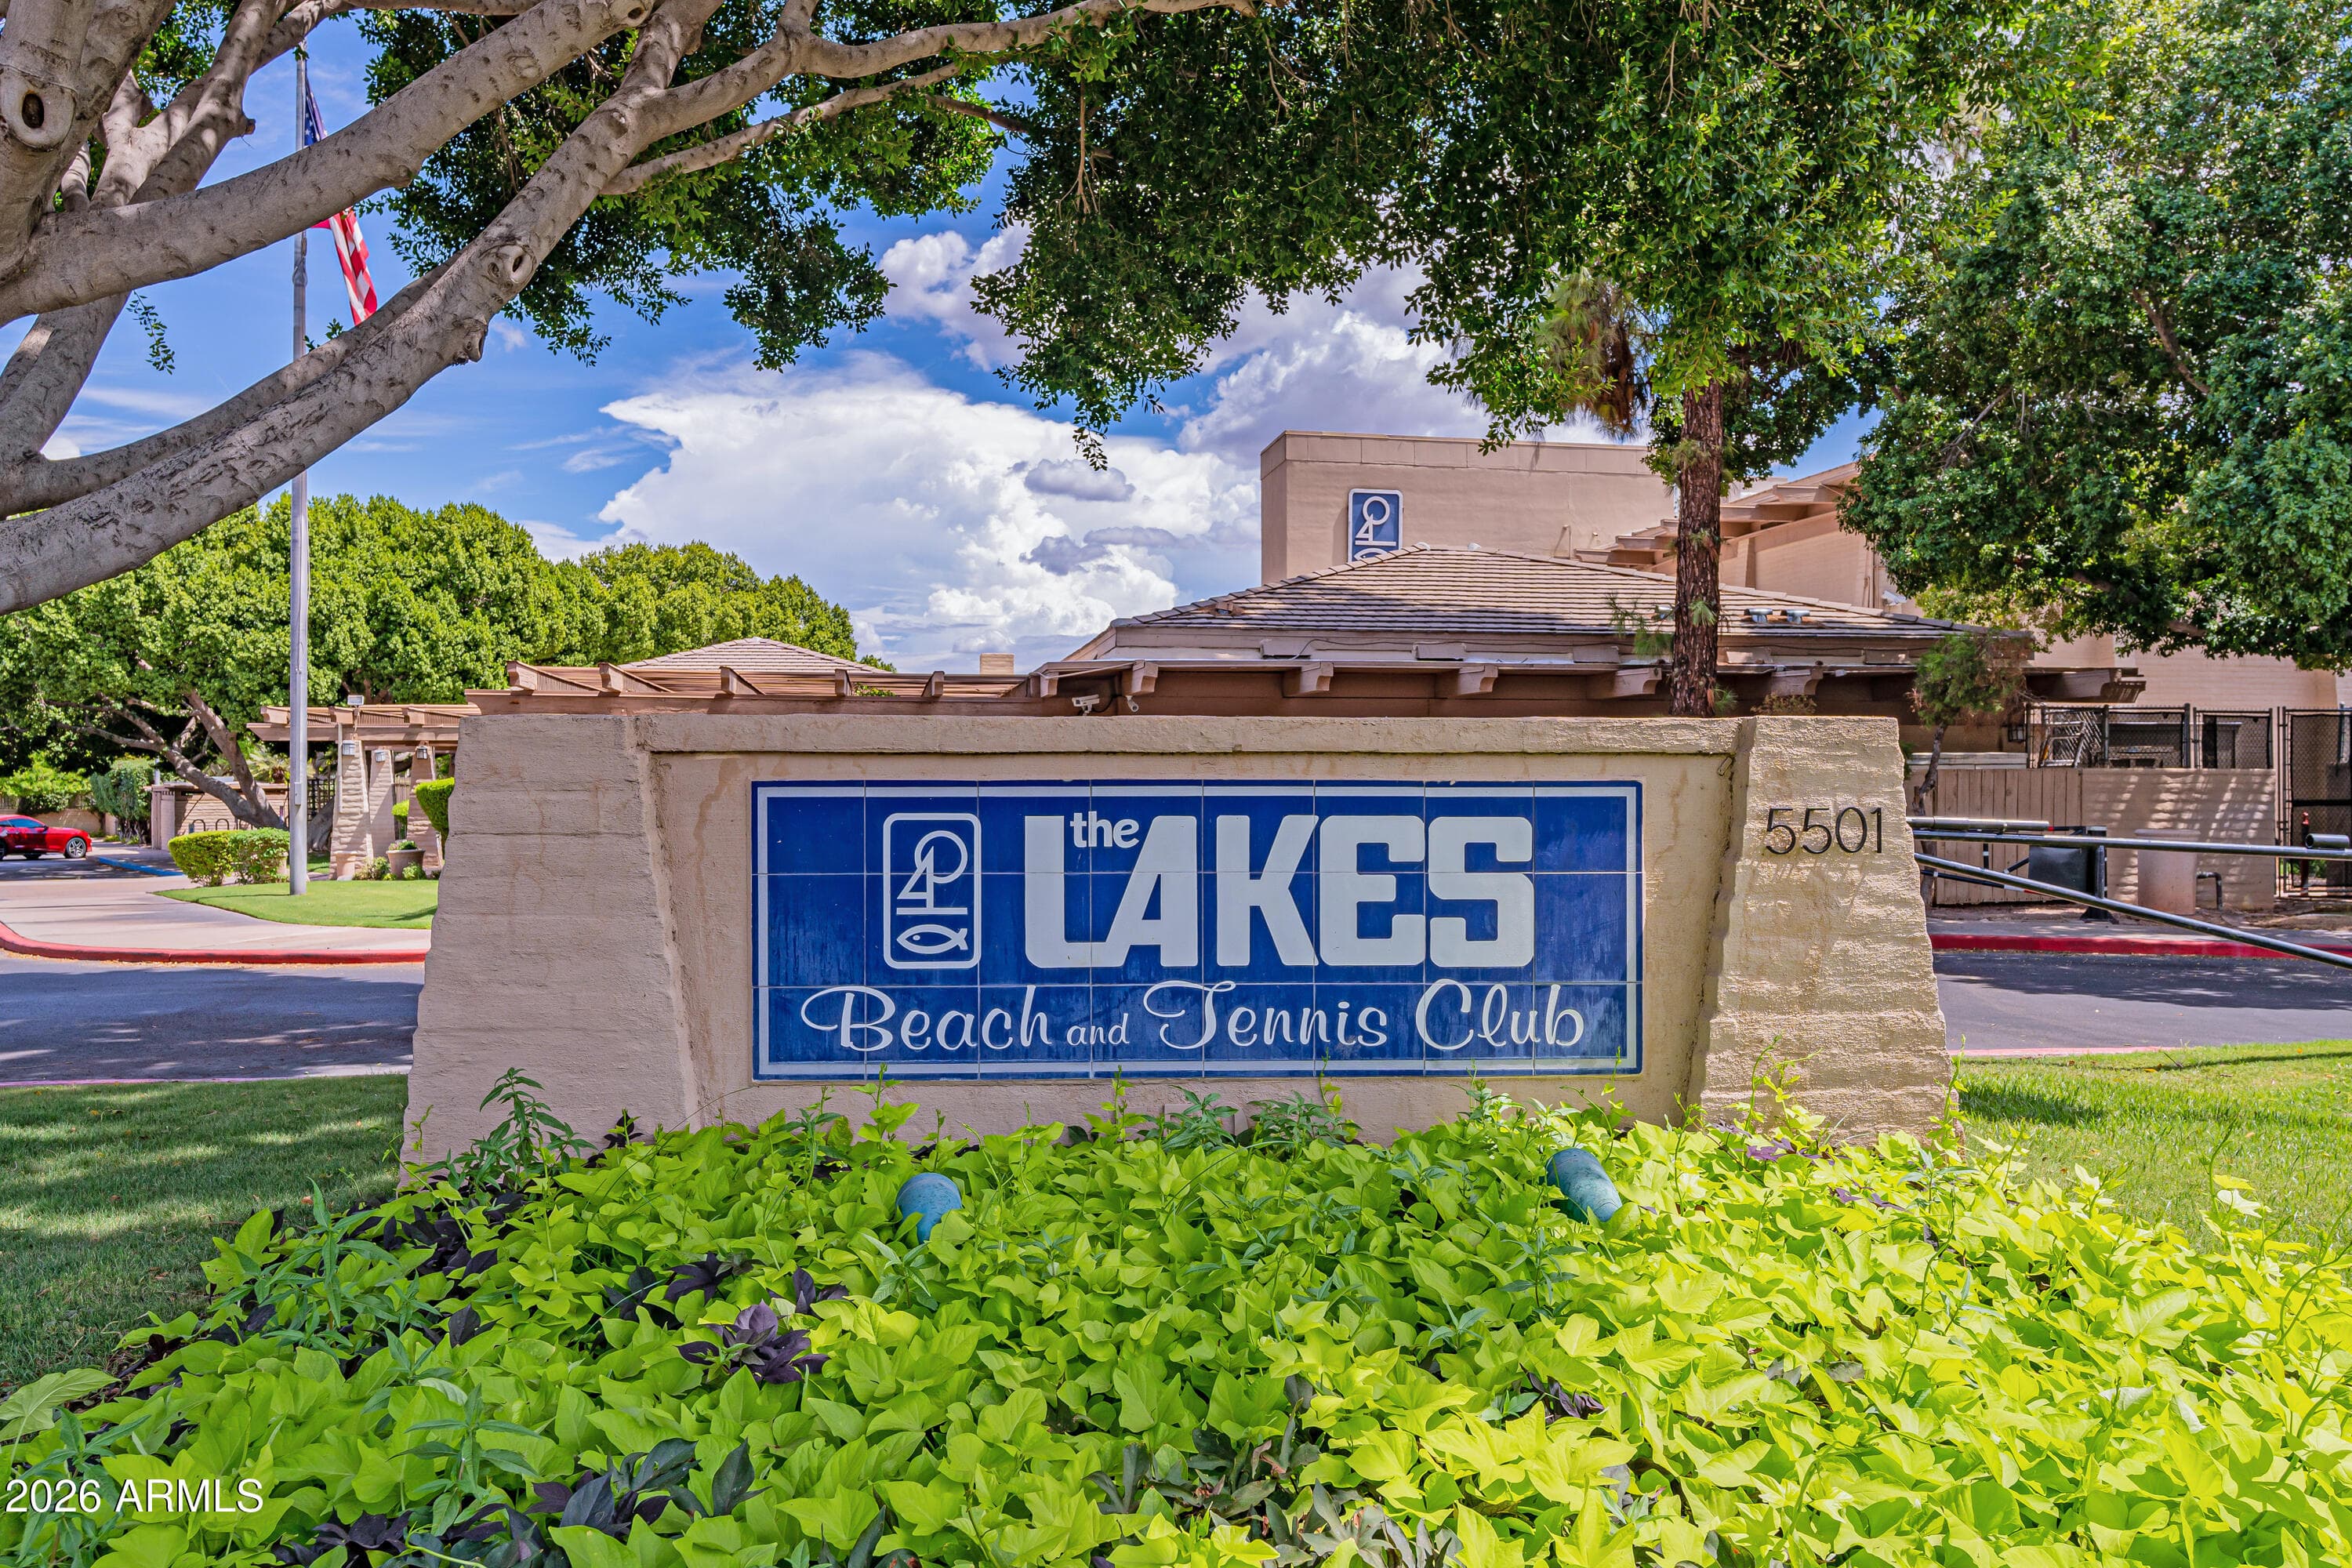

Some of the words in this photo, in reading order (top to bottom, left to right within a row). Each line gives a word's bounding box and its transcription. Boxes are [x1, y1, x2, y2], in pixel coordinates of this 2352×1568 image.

[1069, 811, 1140, 848] the
[1766, 807, 1882, 855] 5501
[1024, 815, 1534, 968] LAKES
[800, 984, 1054, 1052] Beach
[1065, 1012, 1131, 1047] and
[1142, 979, 1389, 1051] Tennis
[1414, 978, 1585, 1051] Club
